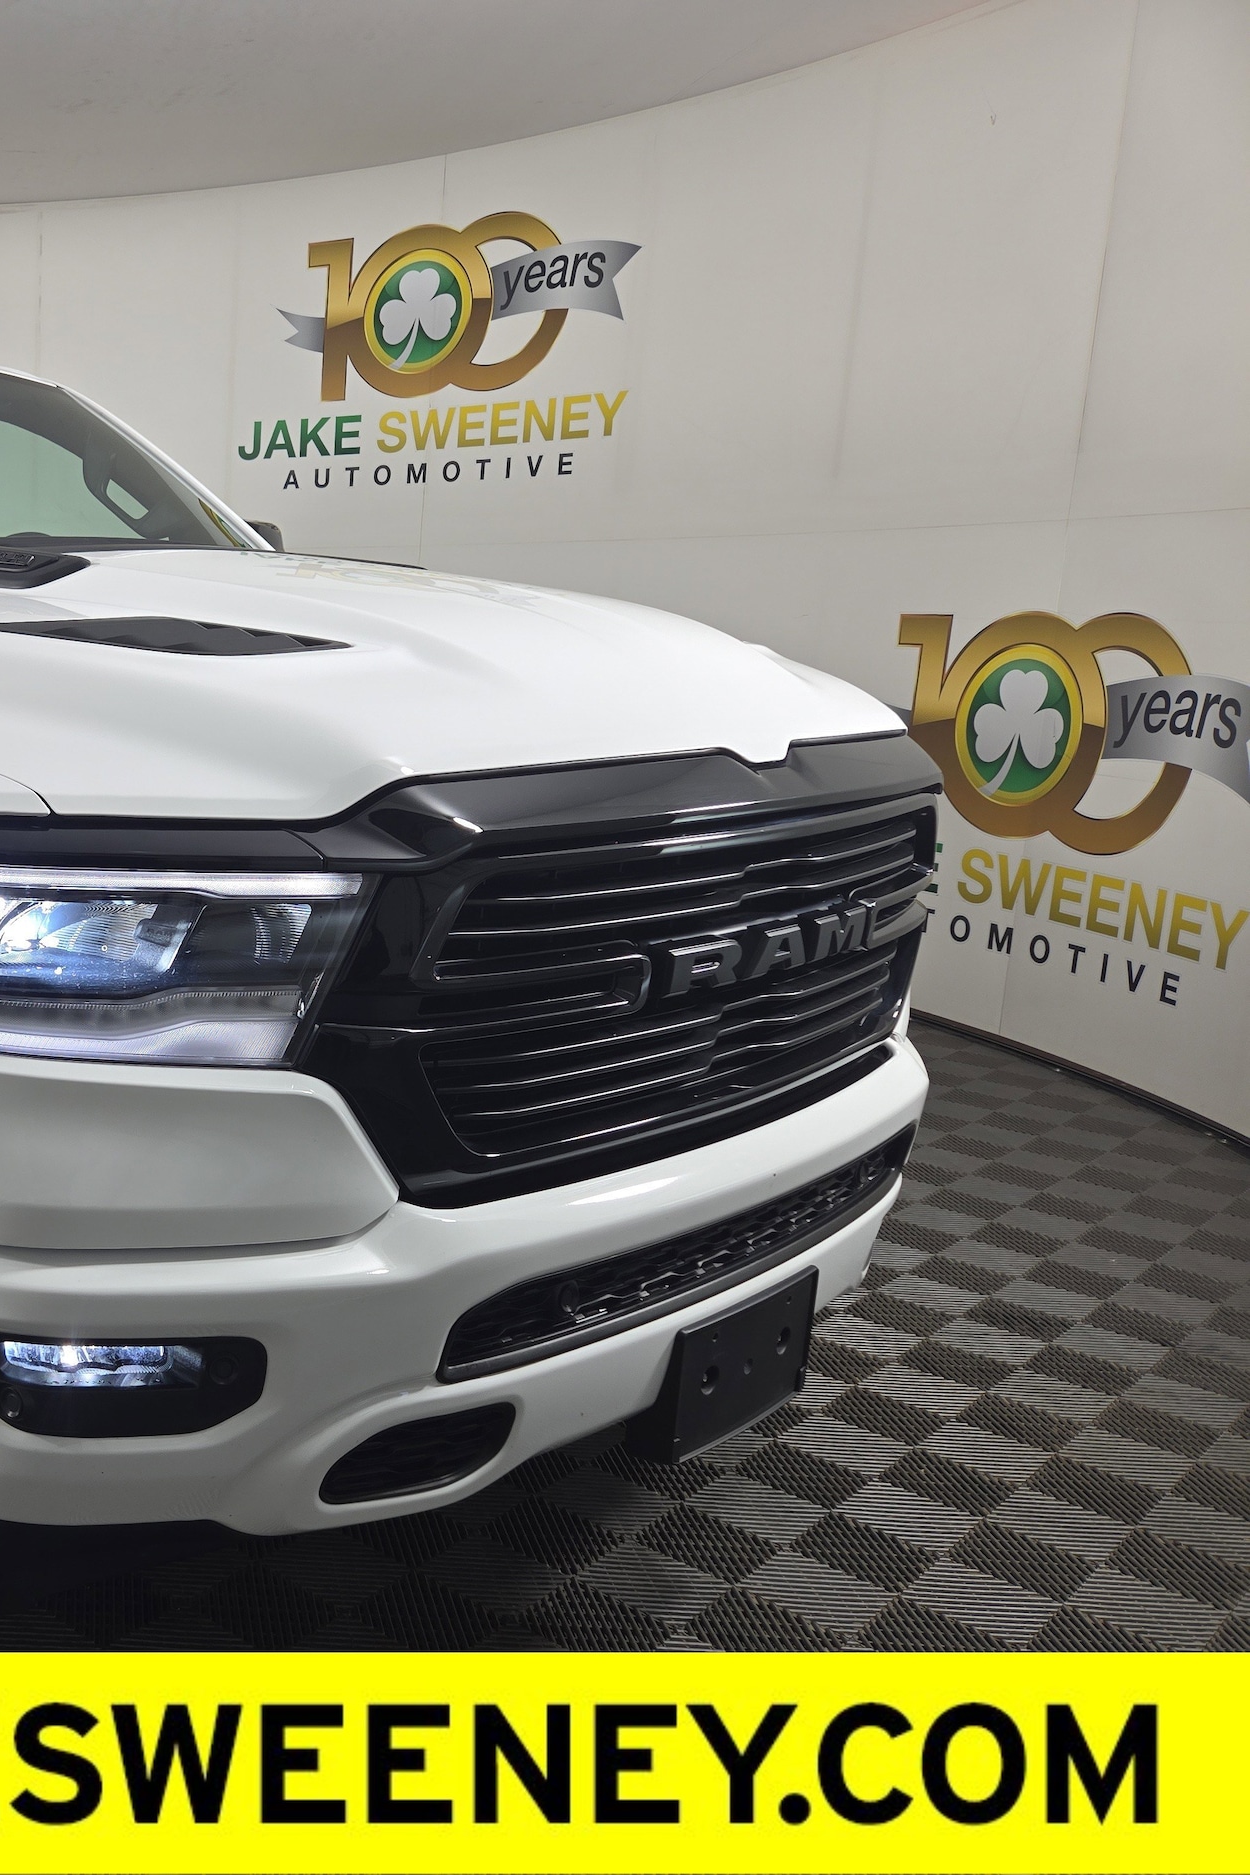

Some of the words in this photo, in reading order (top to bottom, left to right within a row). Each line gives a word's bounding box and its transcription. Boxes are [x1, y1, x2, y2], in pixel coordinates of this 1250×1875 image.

[308, 211, 569, 402] 100
[500, 251, 606, 310] years
[238, 414, 362, 460] JAKE
[377, 390, 629, 453] SWEENEY
[283, 452, 574, 490] AUTOMOTIVE
[1113, 690, 1242, 749] years
[662, 904, 869, 998] RAM
[957, 848, 1250, 973] SWEENEY
